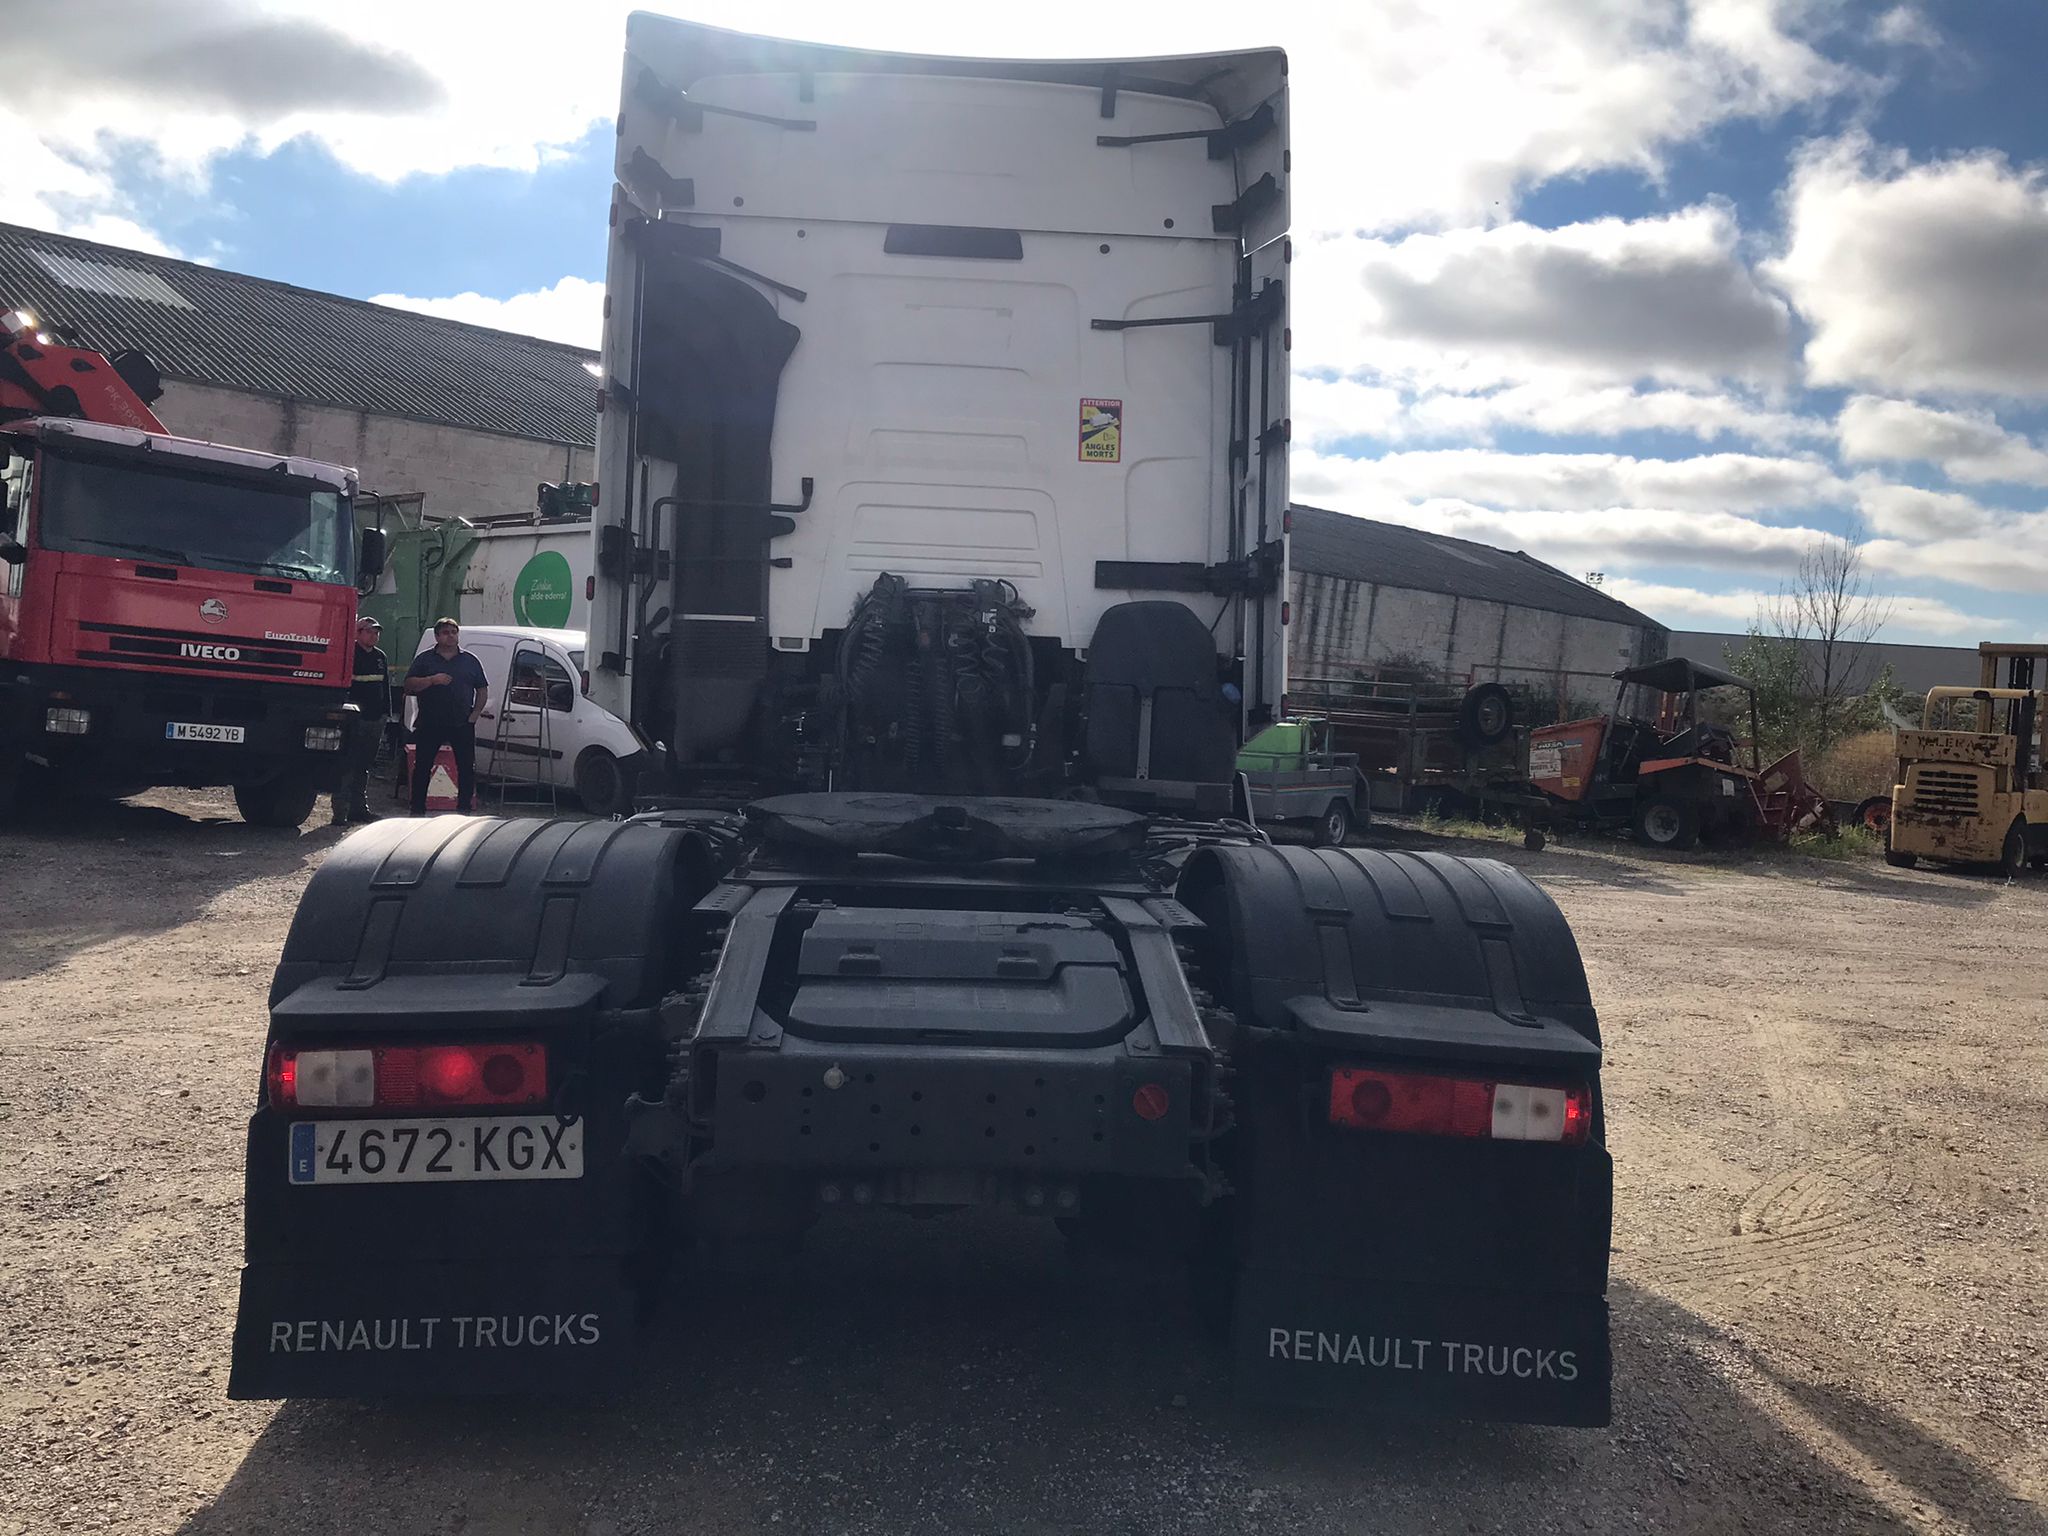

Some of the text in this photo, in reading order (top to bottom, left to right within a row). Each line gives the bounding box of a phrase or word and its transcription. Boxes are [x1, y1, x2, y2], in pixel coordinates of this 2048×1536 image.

[264, 630, 331, 646] EuroTrakker
[180, 643, 241, 661] IVECO
[292, 670, 324, 678] CURSOR
[177, 725, 240, 741] M 5492 YB
[299, 1125, 567, 1175] E 4672 KGX
[269, 1313, 601, 1353] RENAULT TRUCKS
[1268, 1327, 1579, 1381] RENAULT TRUCKS
